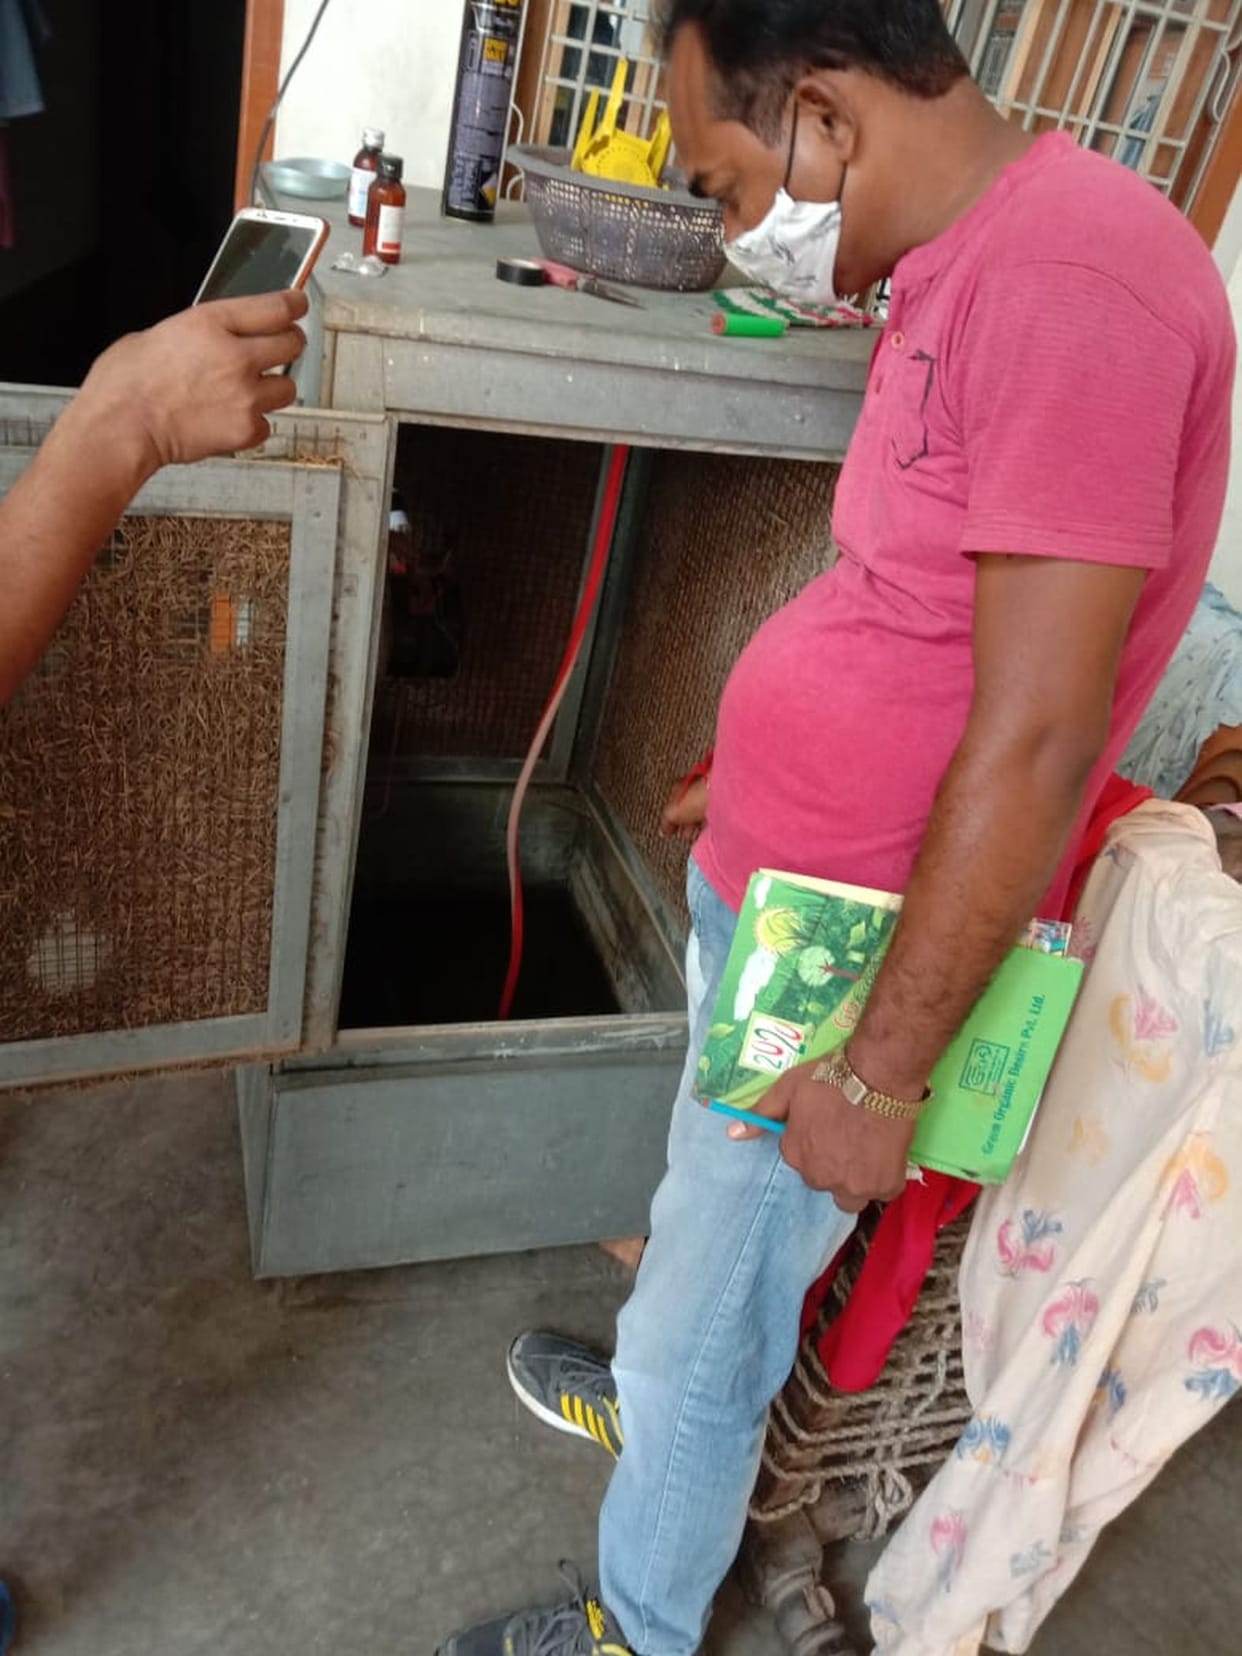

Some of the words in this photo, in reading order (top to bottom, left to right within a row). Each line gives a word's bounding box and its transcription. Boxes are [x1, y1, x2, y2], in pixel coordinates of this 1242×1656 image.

[752, 1022, 806, 1070] 2020
[993, 1080, 1016, 1121] Organic
[1029, 994, 1046, 1015] Ltd.
